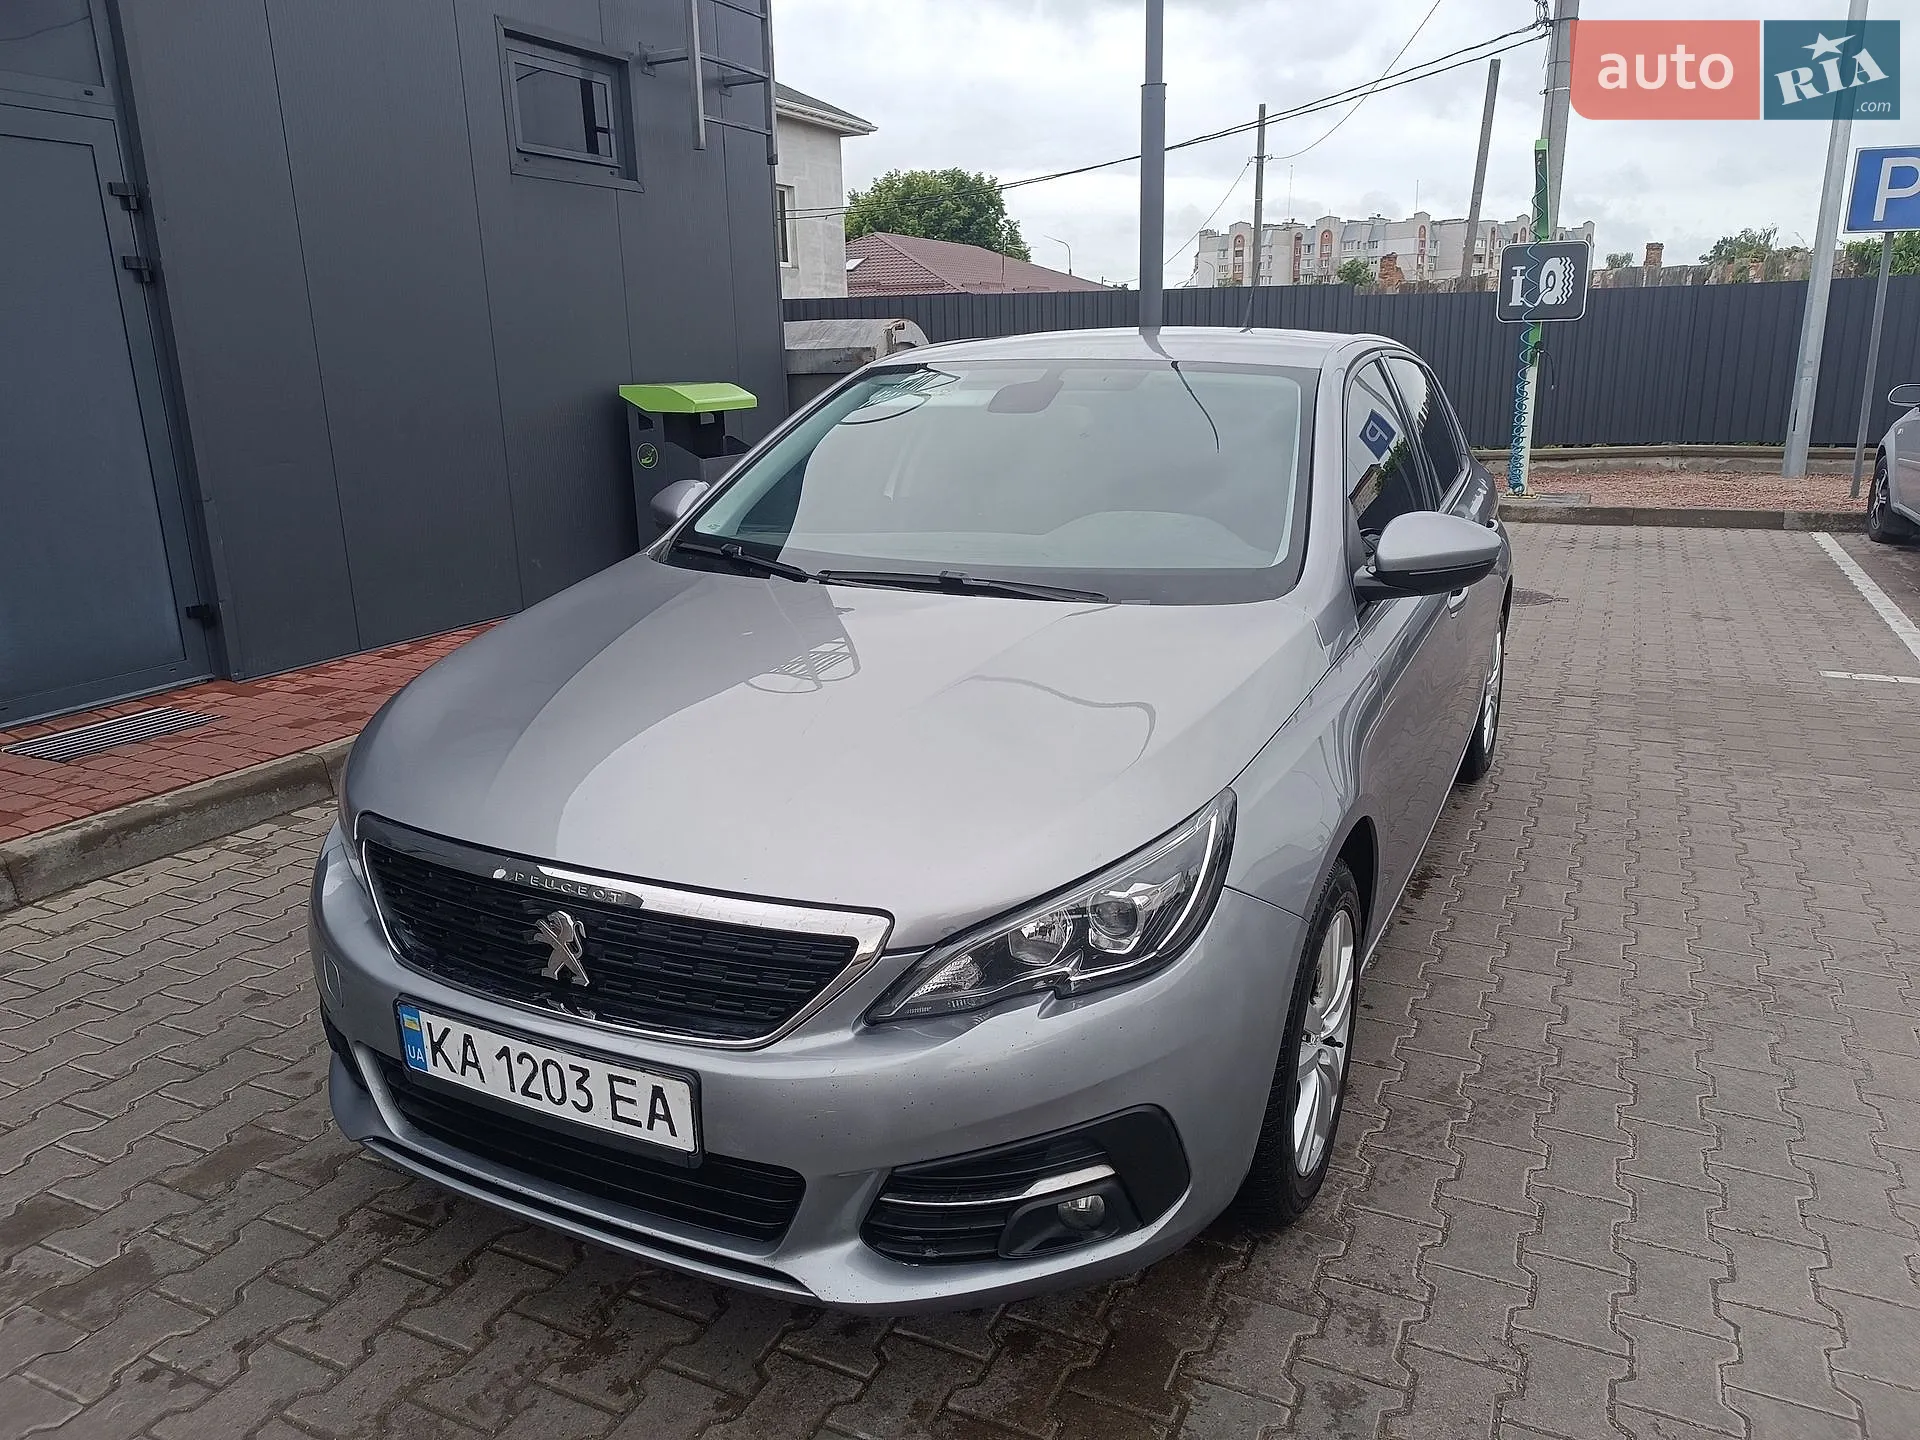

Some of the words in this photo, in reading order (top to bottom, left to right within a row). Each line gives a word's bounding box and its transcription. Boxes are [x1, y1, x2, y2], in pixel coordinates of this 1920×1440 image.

[1873, 157, 1920, 222] P
[514, 871, 622, 903] PEUGEOT
[407, 1046, 424, 1062] UA
[426, 1022, 486, 1083] KA
[495, 1046, 594, 1113] 1203
[608, 1073, 677, 1138] EA
